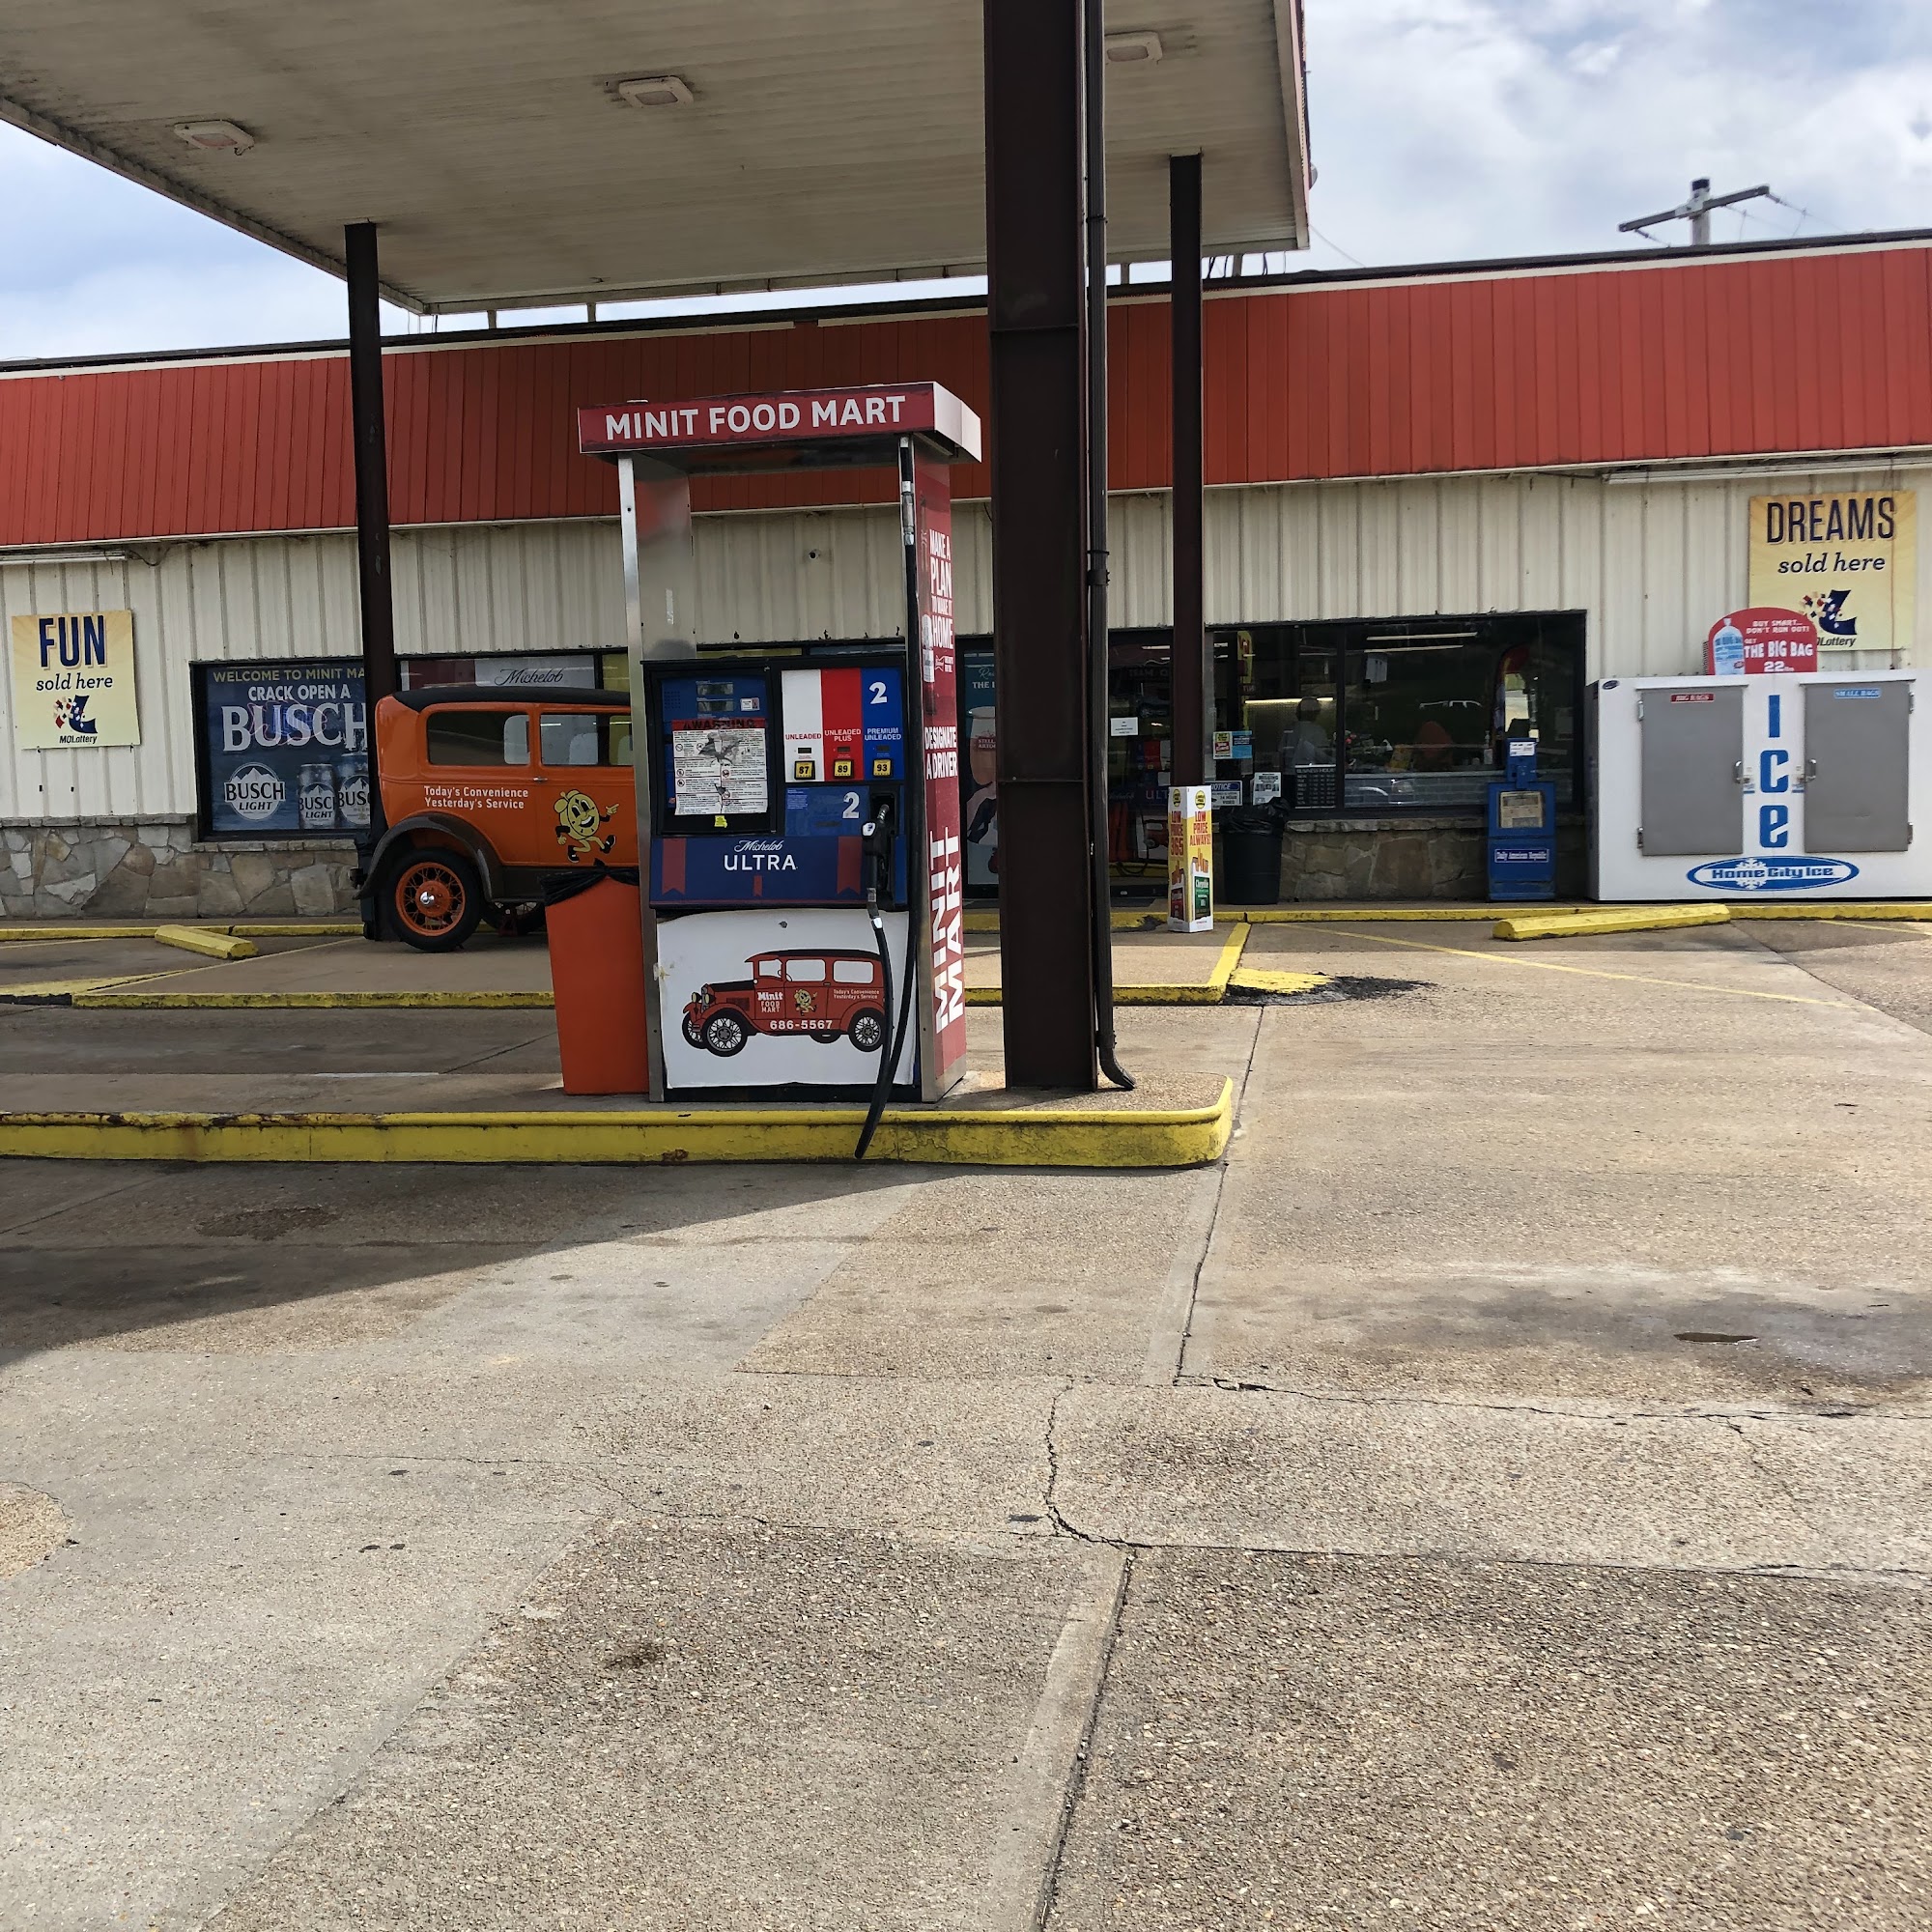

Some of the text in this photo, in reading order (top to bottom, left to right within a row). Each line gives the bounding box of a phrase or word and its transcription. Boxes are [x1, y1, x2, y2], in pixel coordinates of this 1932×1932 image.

[605, 395, 906, 440] MINIT FOOD MART
[1767, 497, 1896, 544] DREAMS
[929, 528, 952, 561] MAKE A
[1777, 552, 1887, 575] sold here
[930, 555, 952, 599] PLAN
[932, 614, 953, 649] HOME
[39, 614, 106, 668] FUN
[1744, 642, 1764, 658] THE
[1768, 640, 1787, 657] BIG
[1790, 641, 1813, 657] BAG
[1817, 637, 1857, 647] Lottery
[36, 672, 113, 691] sold here
[213, 668, 365, 683] WELCOME TO MINIT MA
[495, 668, 564, 685] Michelob
[248, 684, 351, 701] CRACK OPEN A
[869, 681, 888, 704] 2
[221, 701, 367, 752] BUSCH
[59, 735, 98, 745] MOLottery
[924, 725, 957, 750] DESIGNATE
[798, 765, 810, 775] 87
[838, 764, 849, 774] 89
[876, 763, 888, 772] 93
[926, 751, 957, 780] A DRIVER
[225, 781, 285, 802] BUSCH
[424, 785, 528, 799] Today's Convenience
[1146, 789, 1167, 800] ULT
[239, 801, 272, 810] LIGHT
[424, 798, 525, 810] Yesterday's Service
[842, 791, 860, 819] 2
[1195, 810, 1207, 822] LOW
[733, 839, 784, 852] Michelob
[724, 854, 796, 870] ULTRA
[1712, 867, 1833, 879] Home City Ice
[930, 830, 948, 1035] MINIT
[945, 826, 963, 1023] MART
[757, 991, 783, 1001] Minit
[769, 1019, 833, 1030] 686-5567
